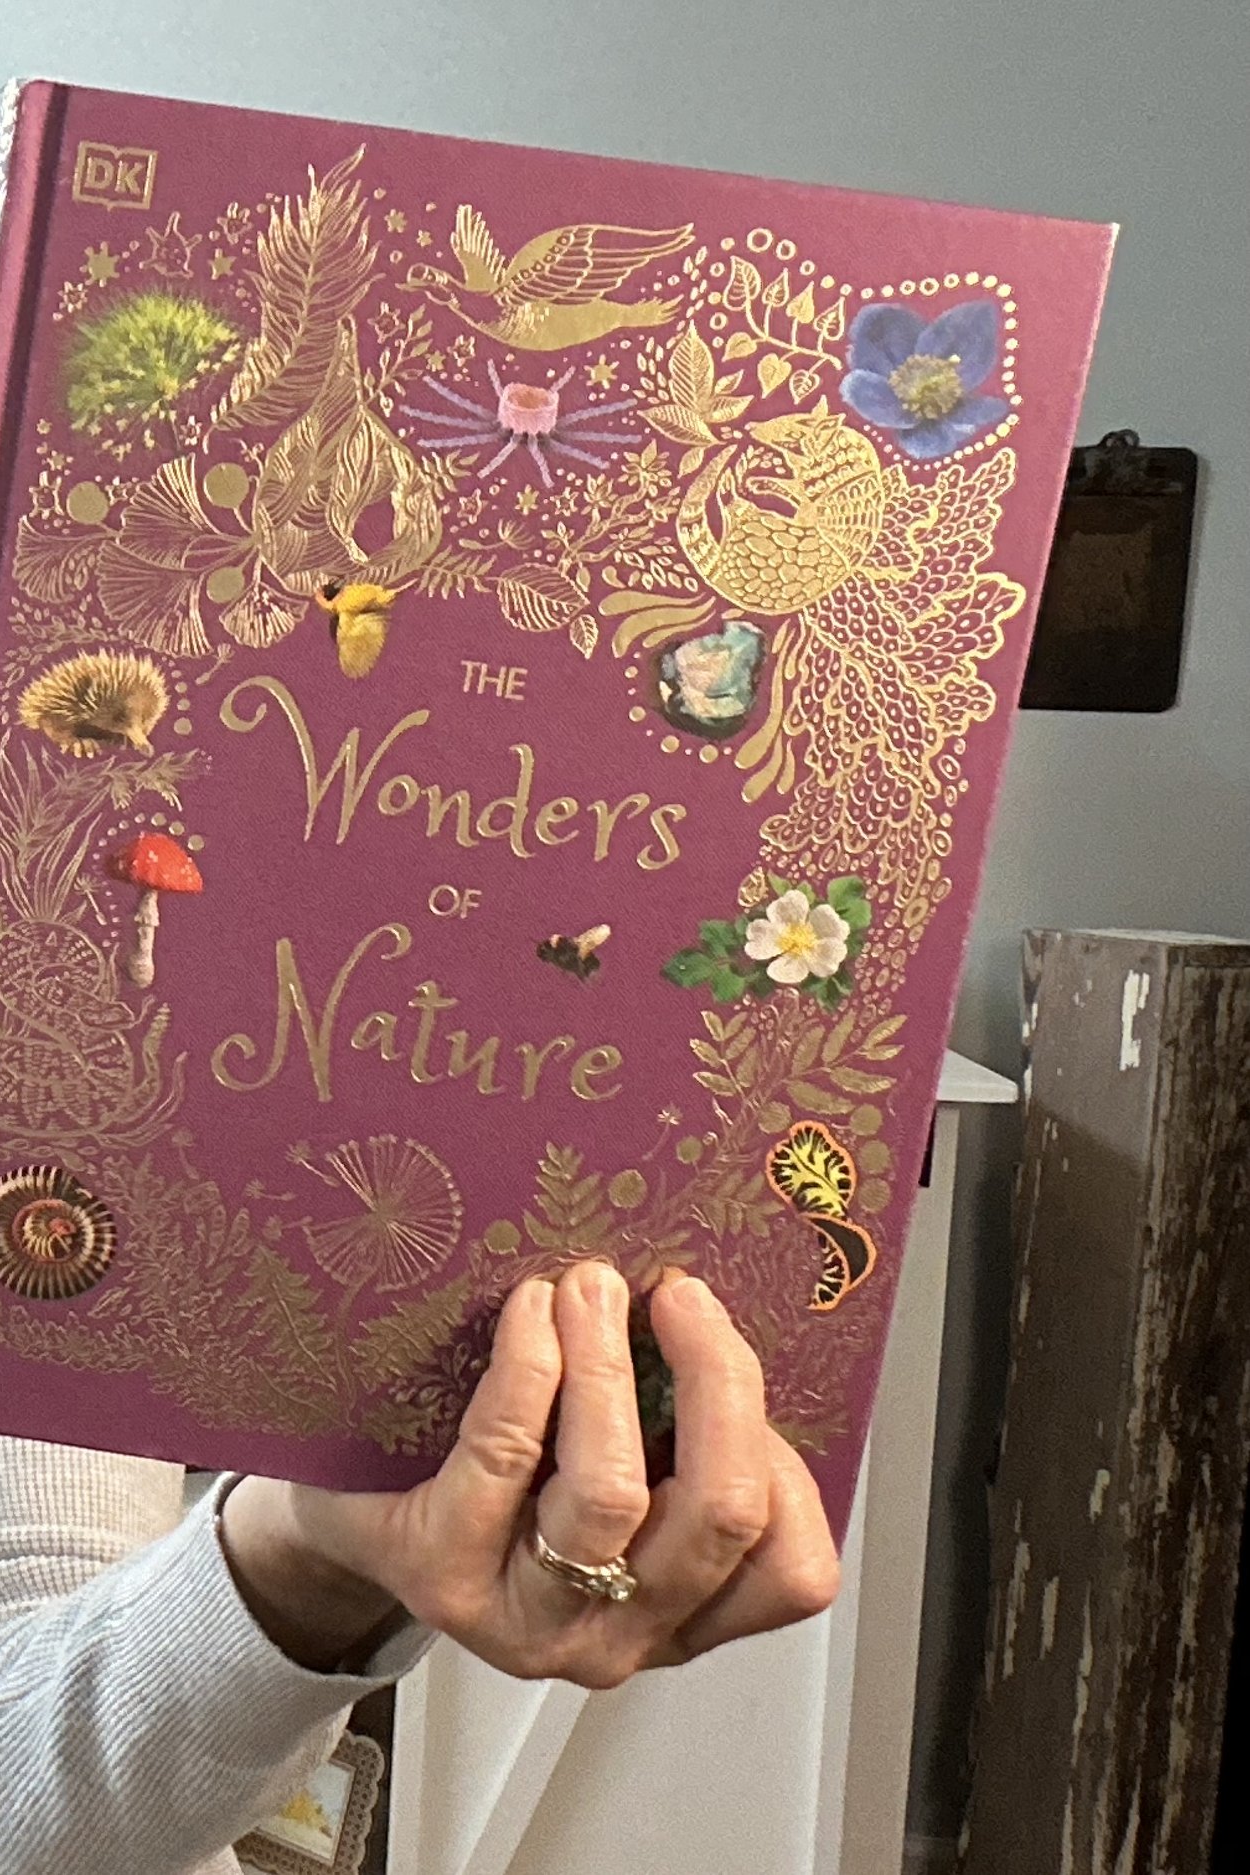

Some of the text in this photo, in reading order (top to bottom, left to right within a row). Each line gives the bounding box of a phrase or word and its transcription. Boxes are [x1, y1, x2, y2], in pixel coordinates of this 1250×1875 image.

[84, 156, 143, 195] DK
[460, 659, 529, 701] THE
[218, 674, 688, 871] Wonders
[427, 884, 483, 919] OF
[210, 922, 623, 1102] Nature
